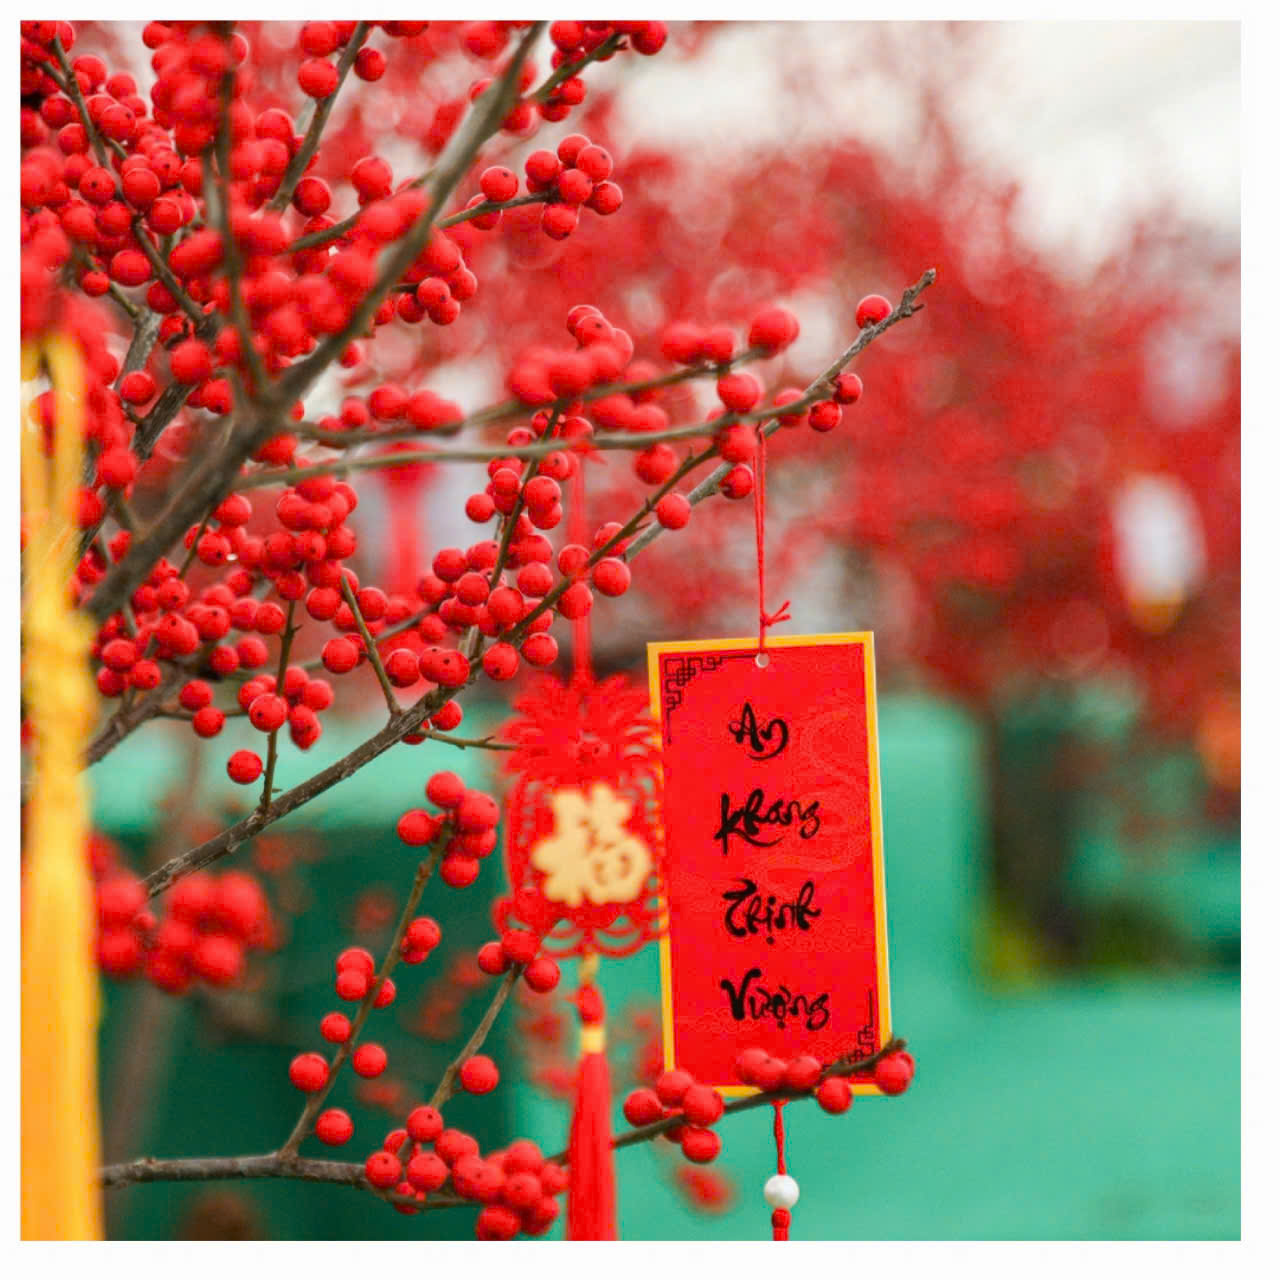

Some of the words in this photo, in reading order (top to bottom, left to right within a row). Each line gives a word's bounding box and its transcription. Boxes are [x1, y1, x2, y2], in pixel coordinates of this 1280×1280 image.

[727, 701, 789, 761] An
[713, 788, 821, 856] Khang
[722, 877, 822, 945] Thịnh
[719, 967, 830, 1032] Vượng
